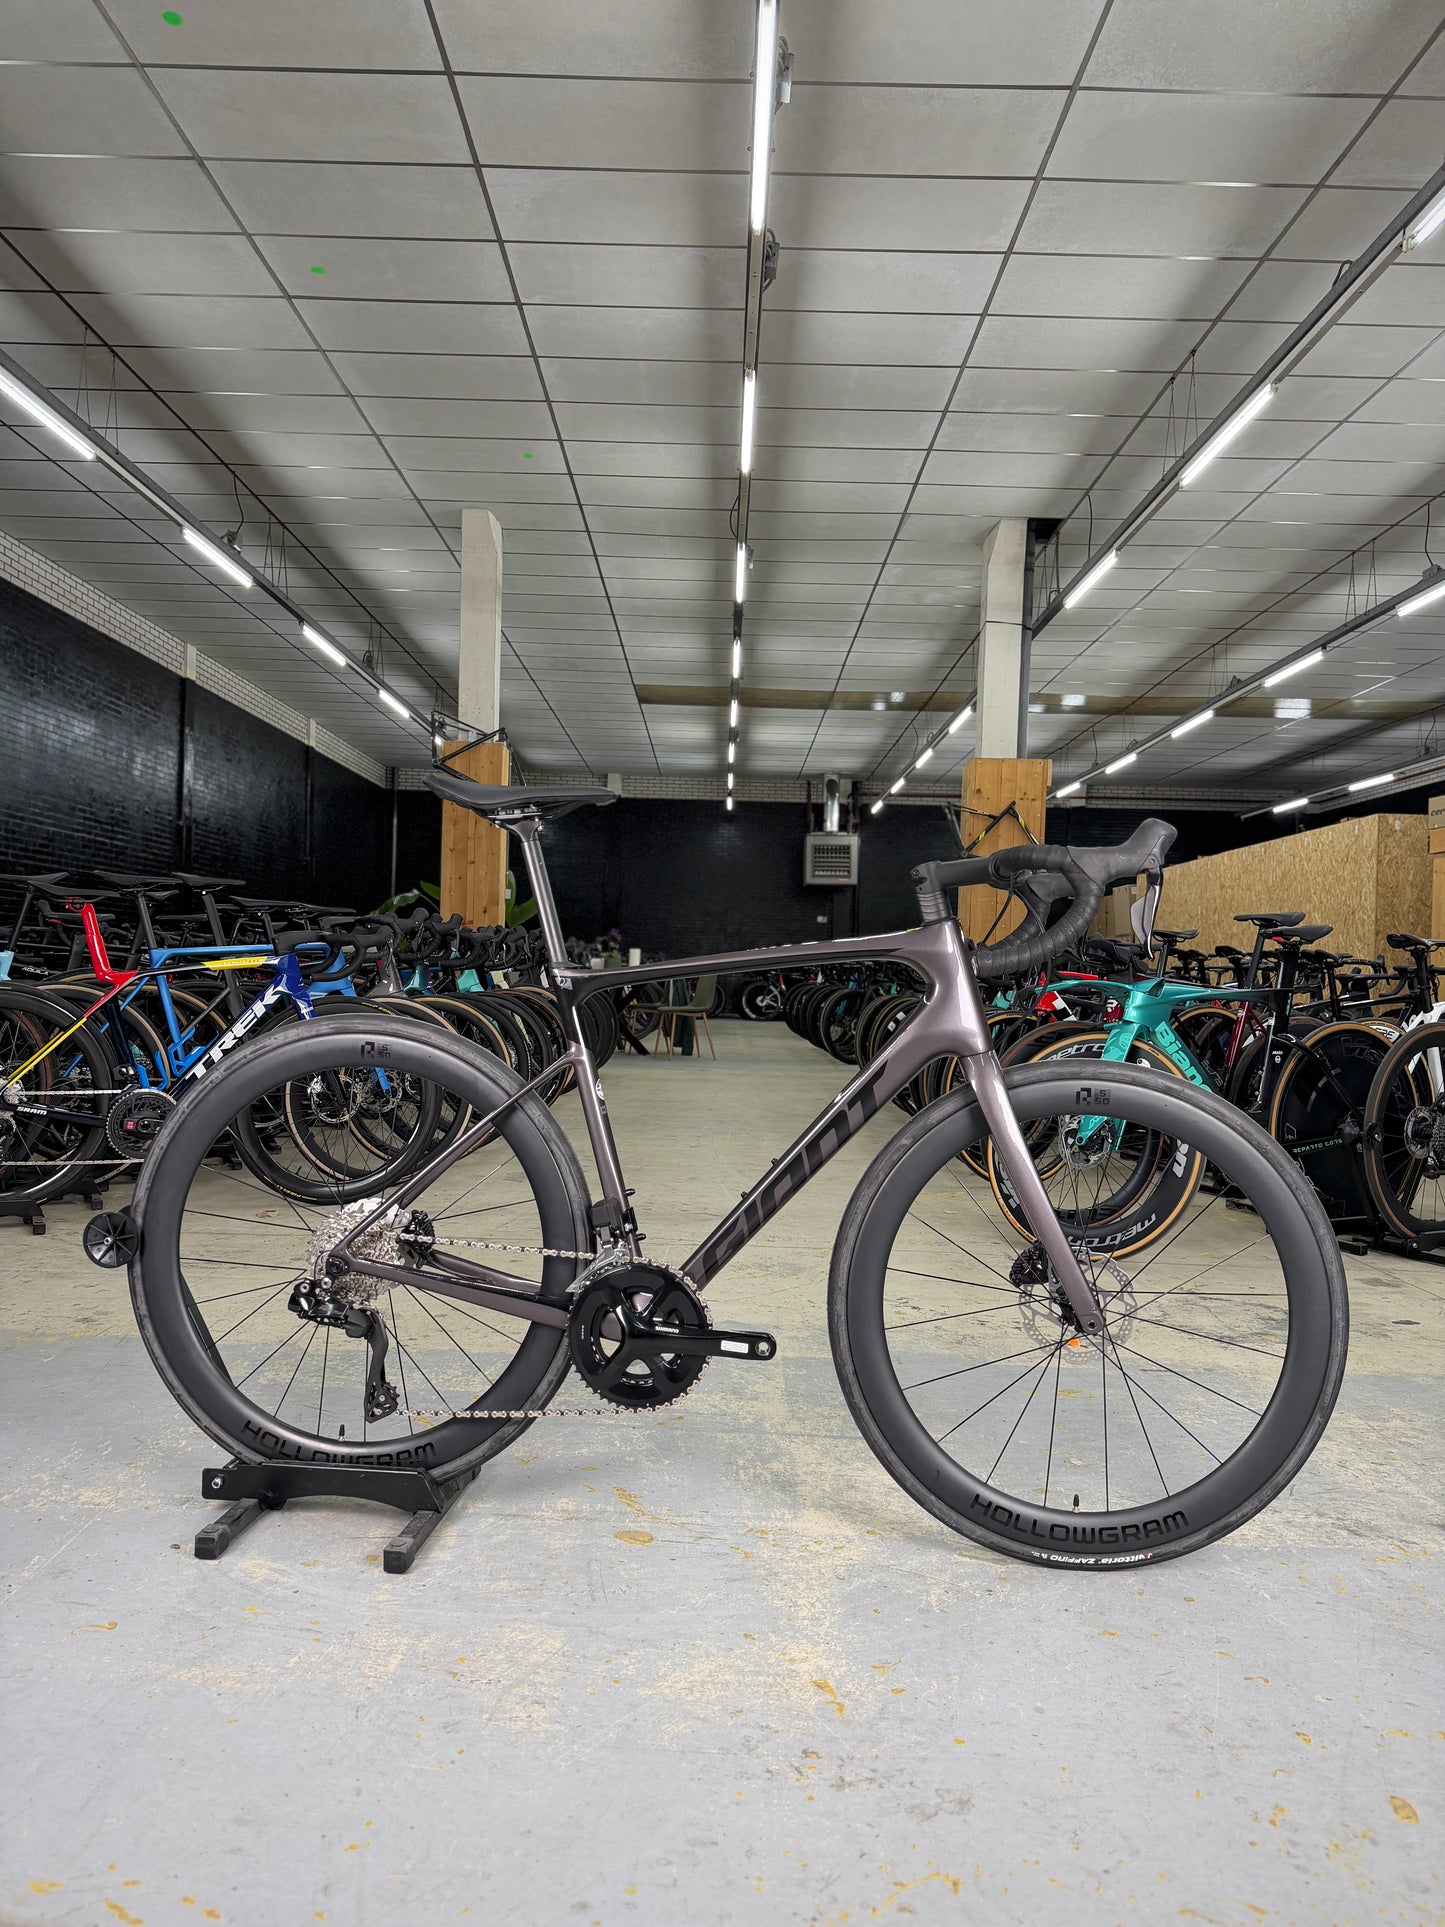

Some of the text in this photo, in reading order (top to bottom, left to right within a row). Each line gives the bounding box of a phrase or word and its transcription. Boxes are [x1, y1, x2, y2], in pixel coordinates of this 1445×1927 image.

[185, 984, 281, 1080] TREK
[16, 1106, 48, 1116] SRAM
[1324, 1138, 1343, 1147] CORS
[655, 1325, 680, 1334] SHIMANO
[969, 1492, 1191, 1545] HOLLOWGRAM
